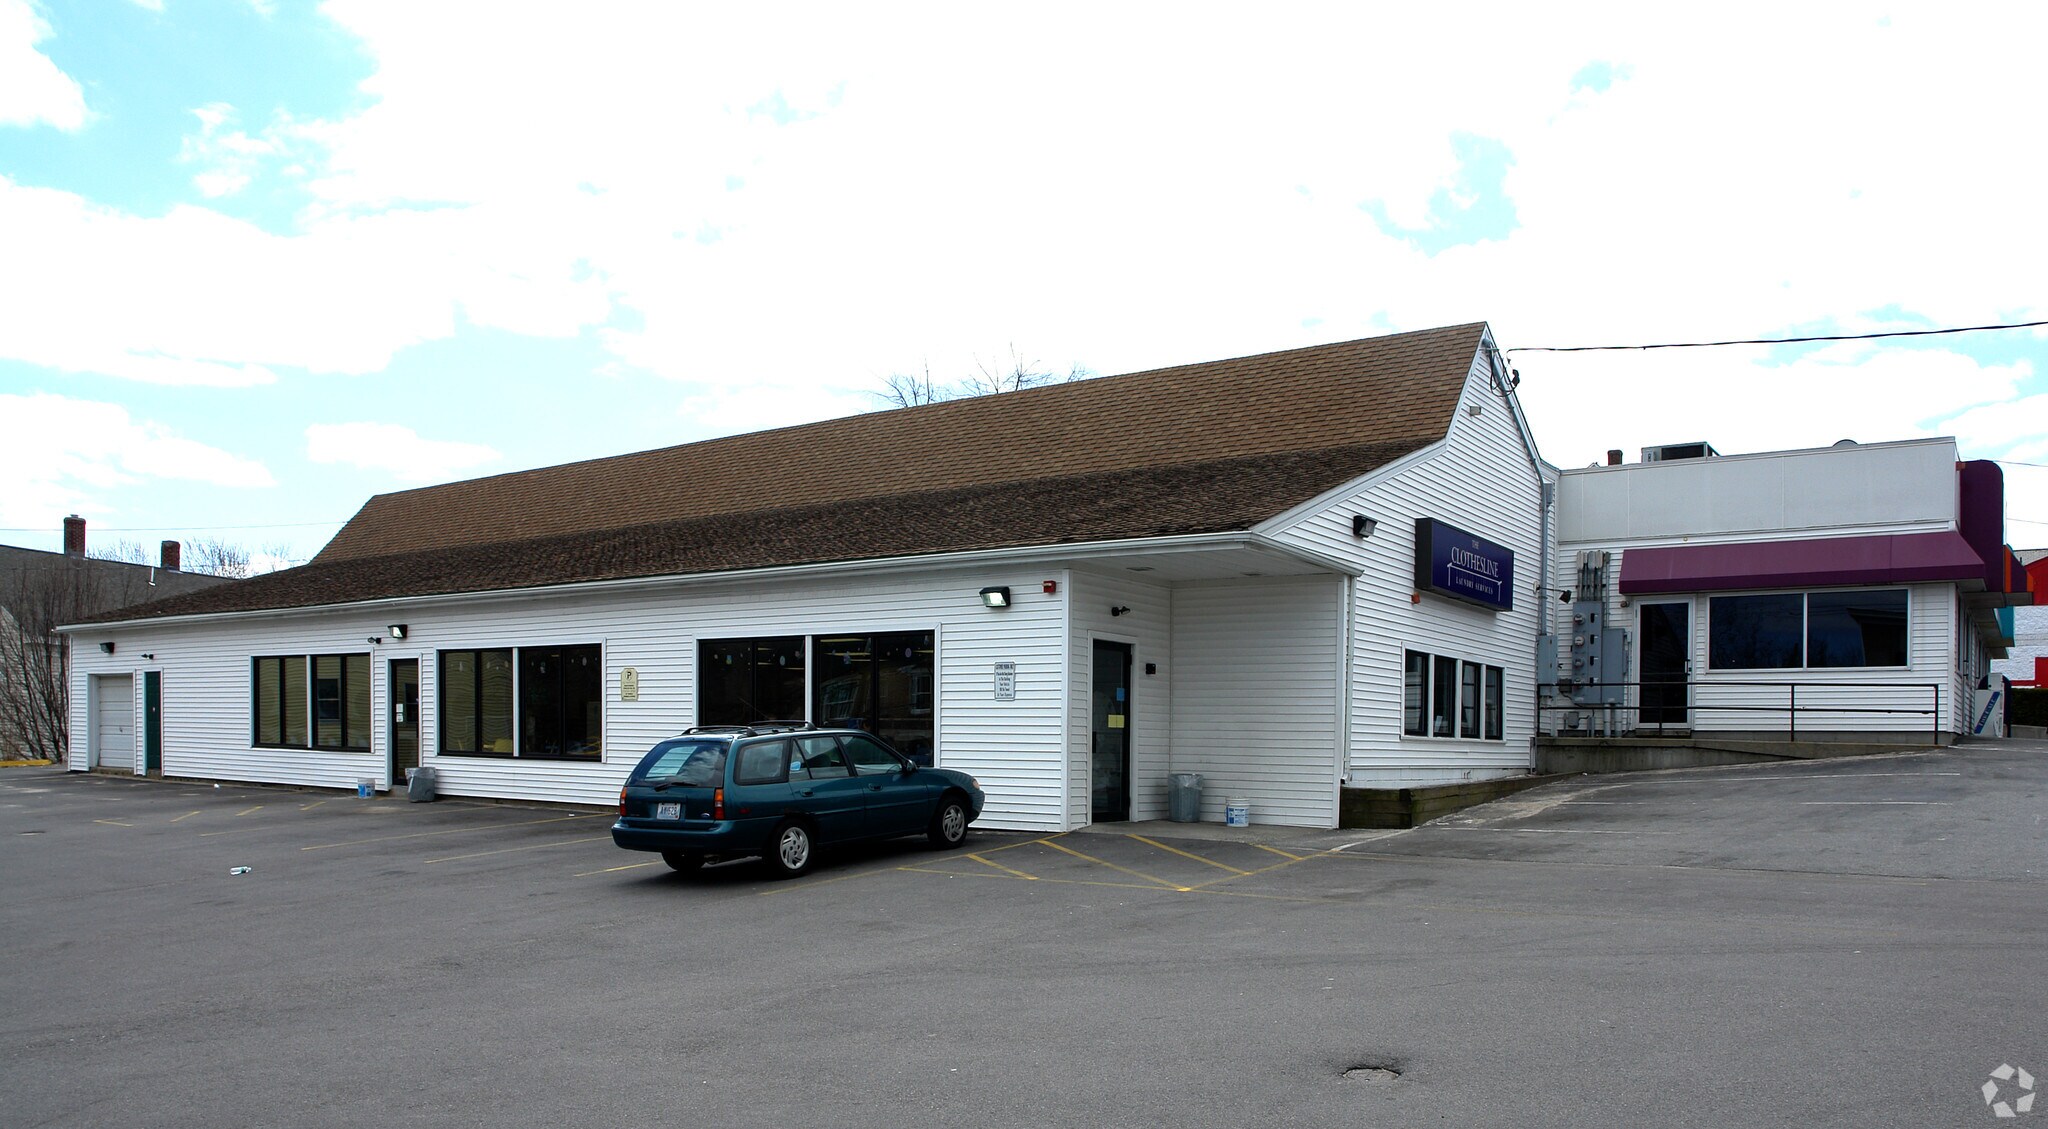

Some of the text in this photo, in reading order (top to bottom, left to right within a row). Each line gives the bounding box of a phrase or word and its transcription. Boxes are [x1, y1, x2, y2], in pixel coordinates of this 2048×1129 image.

[1471, 540, 1479, 549] THE
[1451, 547, 1499, 577] CLOTHESLINE
[1456, 577, 1494, 595] LAUNDRY SERVICES
